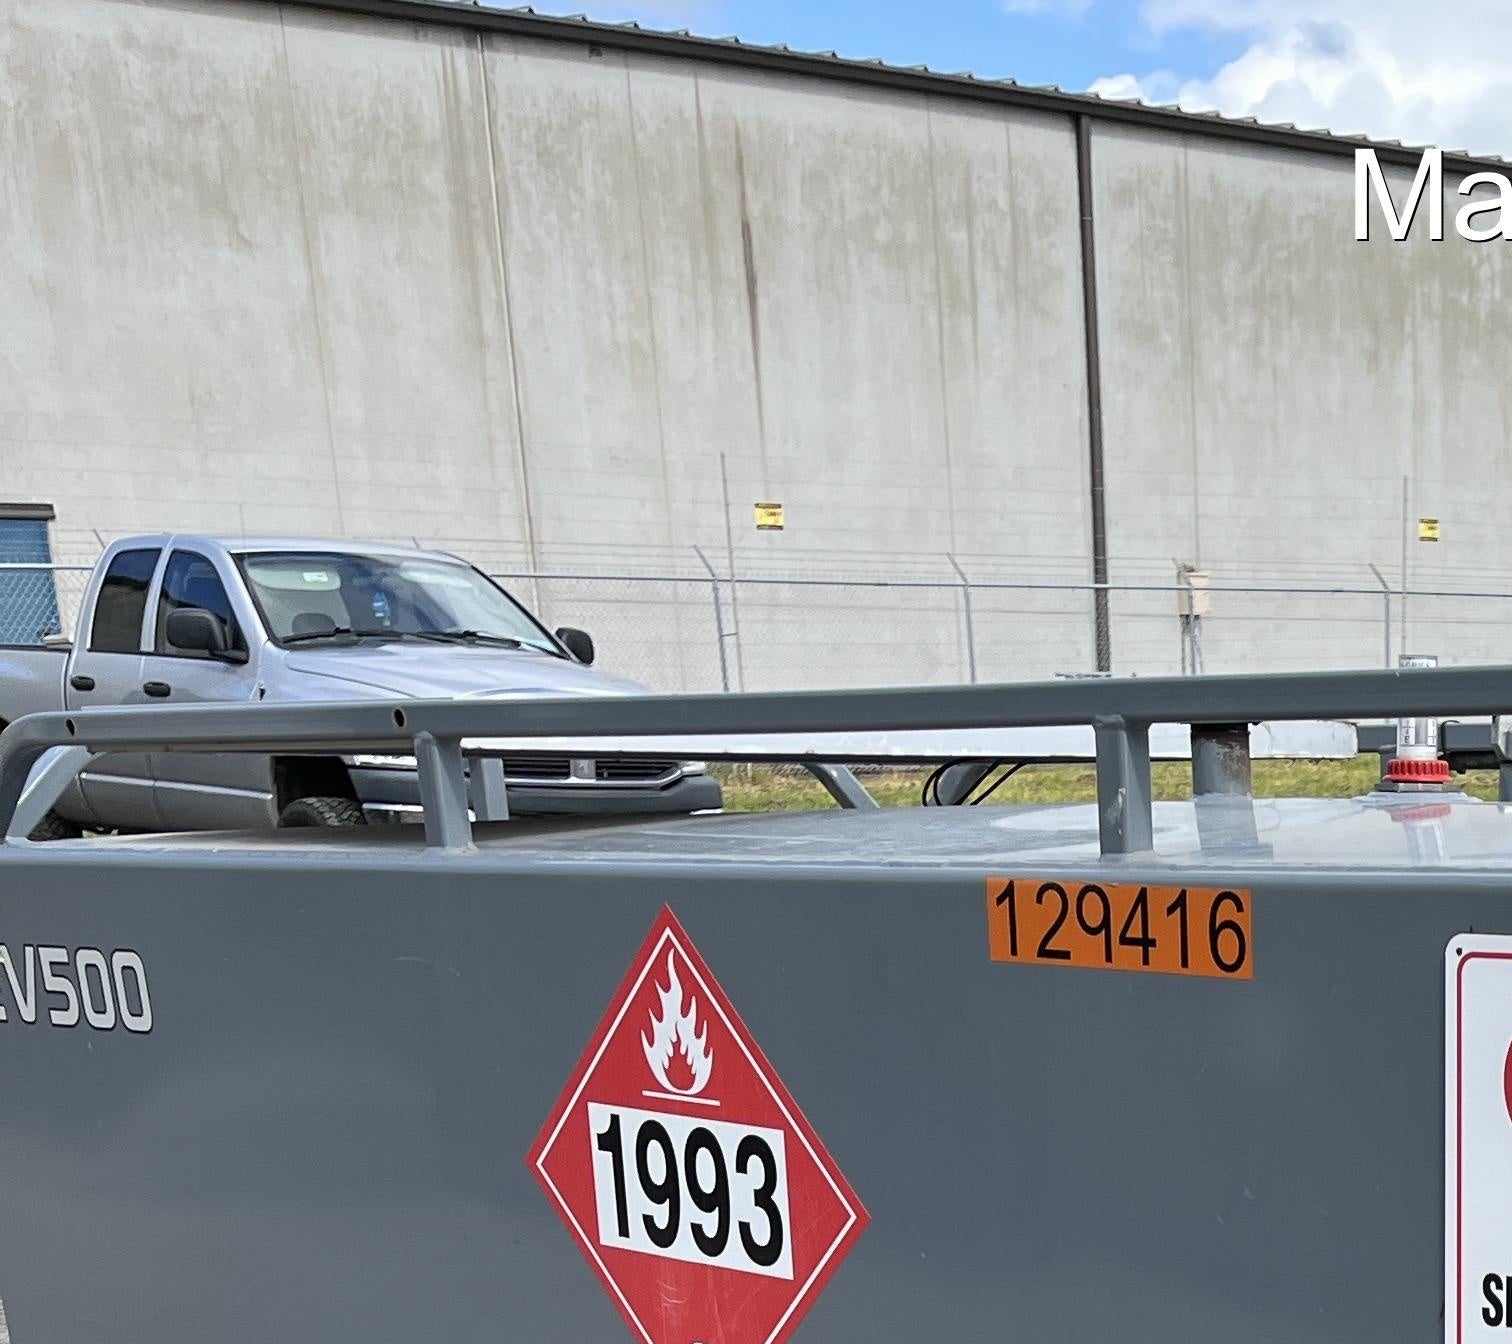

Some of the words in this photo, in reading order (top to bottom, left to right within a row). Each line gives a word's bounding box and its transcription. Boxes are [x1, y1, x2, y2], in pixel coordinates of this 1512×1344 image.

[994, 878, 1247, 973] 129416
[0, 942, 153, 1034] V500
[596, 1112, 785, 1268] 1993
